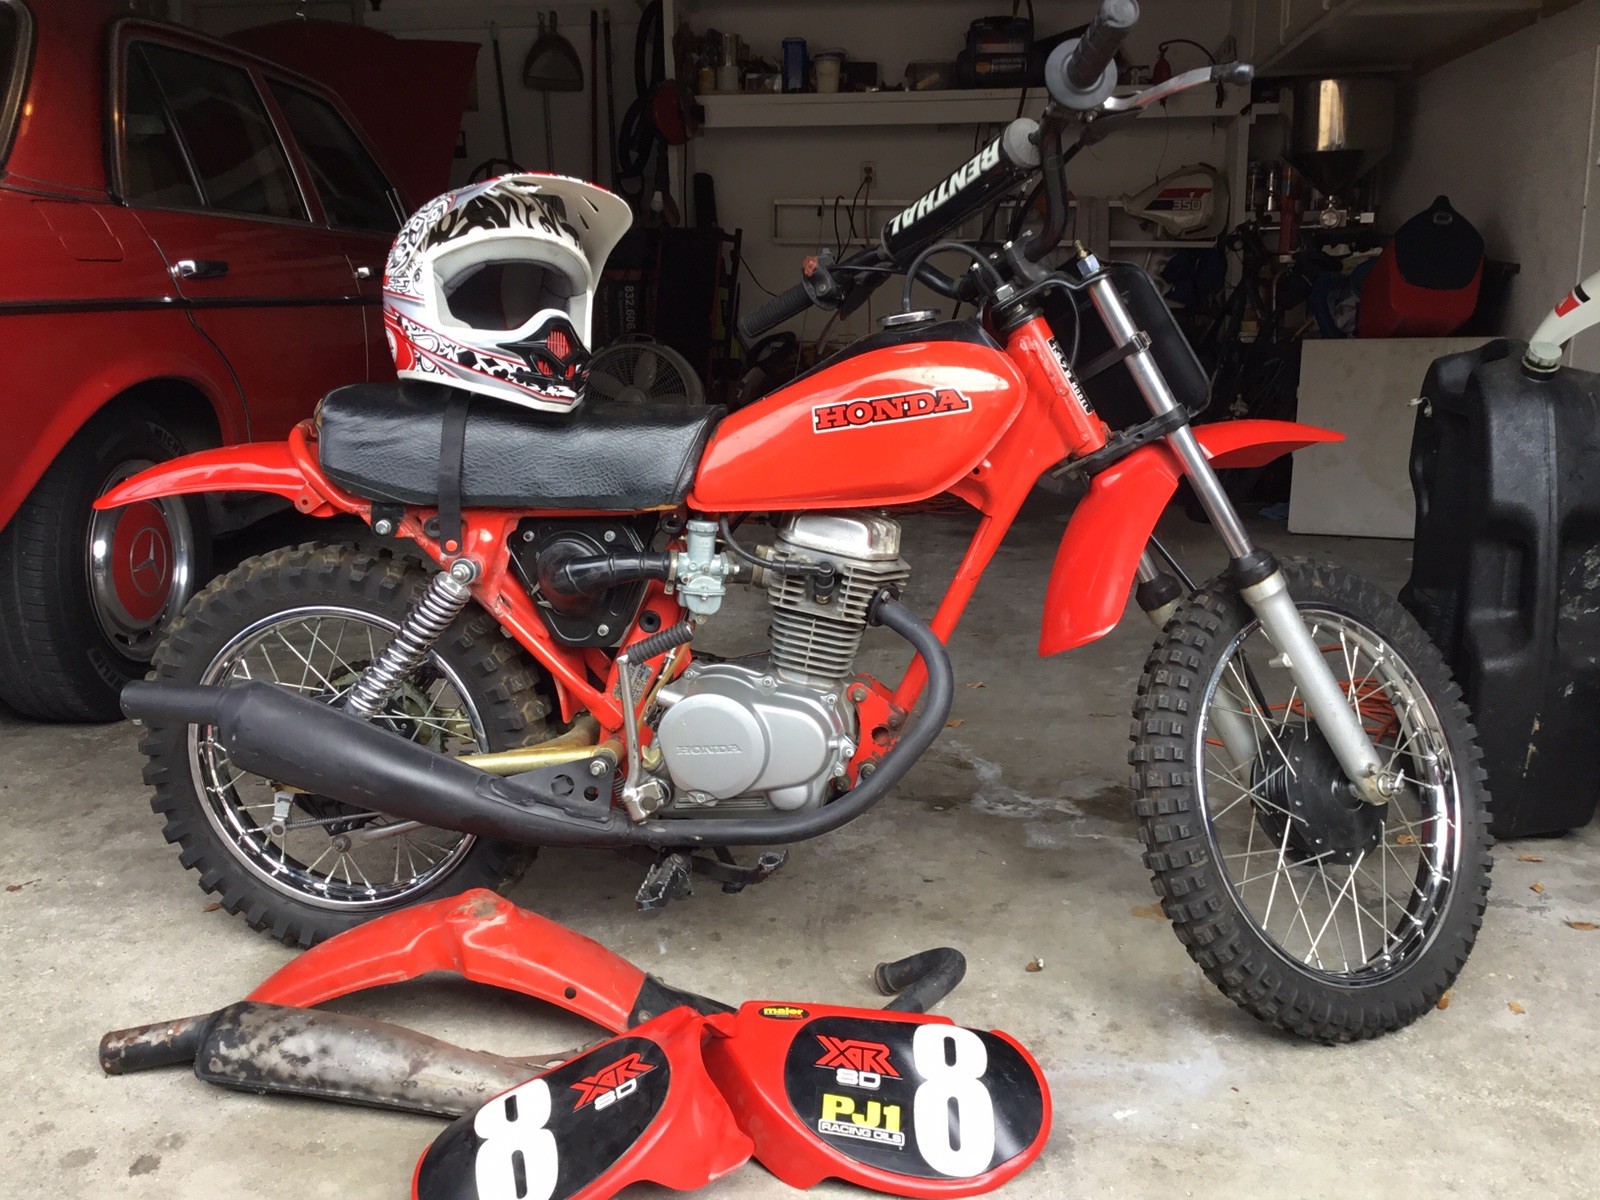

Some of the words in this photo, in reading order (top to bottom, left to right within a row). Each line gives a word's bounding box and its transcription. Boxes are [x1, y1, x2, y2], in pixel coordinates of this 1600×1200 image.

[889, 137, 1000, 236] RENTHAL
[1173, 200, 1200, 210] 350
[624, 286, 635, 332] 832.606.
[814, 387, 970, 431] HONDA
[676, 744, 742, 755] HONDA
[815, 1034, 901, 1078] XR
[569, 1051, 656, 1112] XR
[913, 1025, 995, 1176] 8
[821, 1093, 901, 1132] PJ1
[821, 1123, 872, 1138] RACING
[873, 1130, 902, 1143] OILS
[474, 1078, 559, 1200] 8
